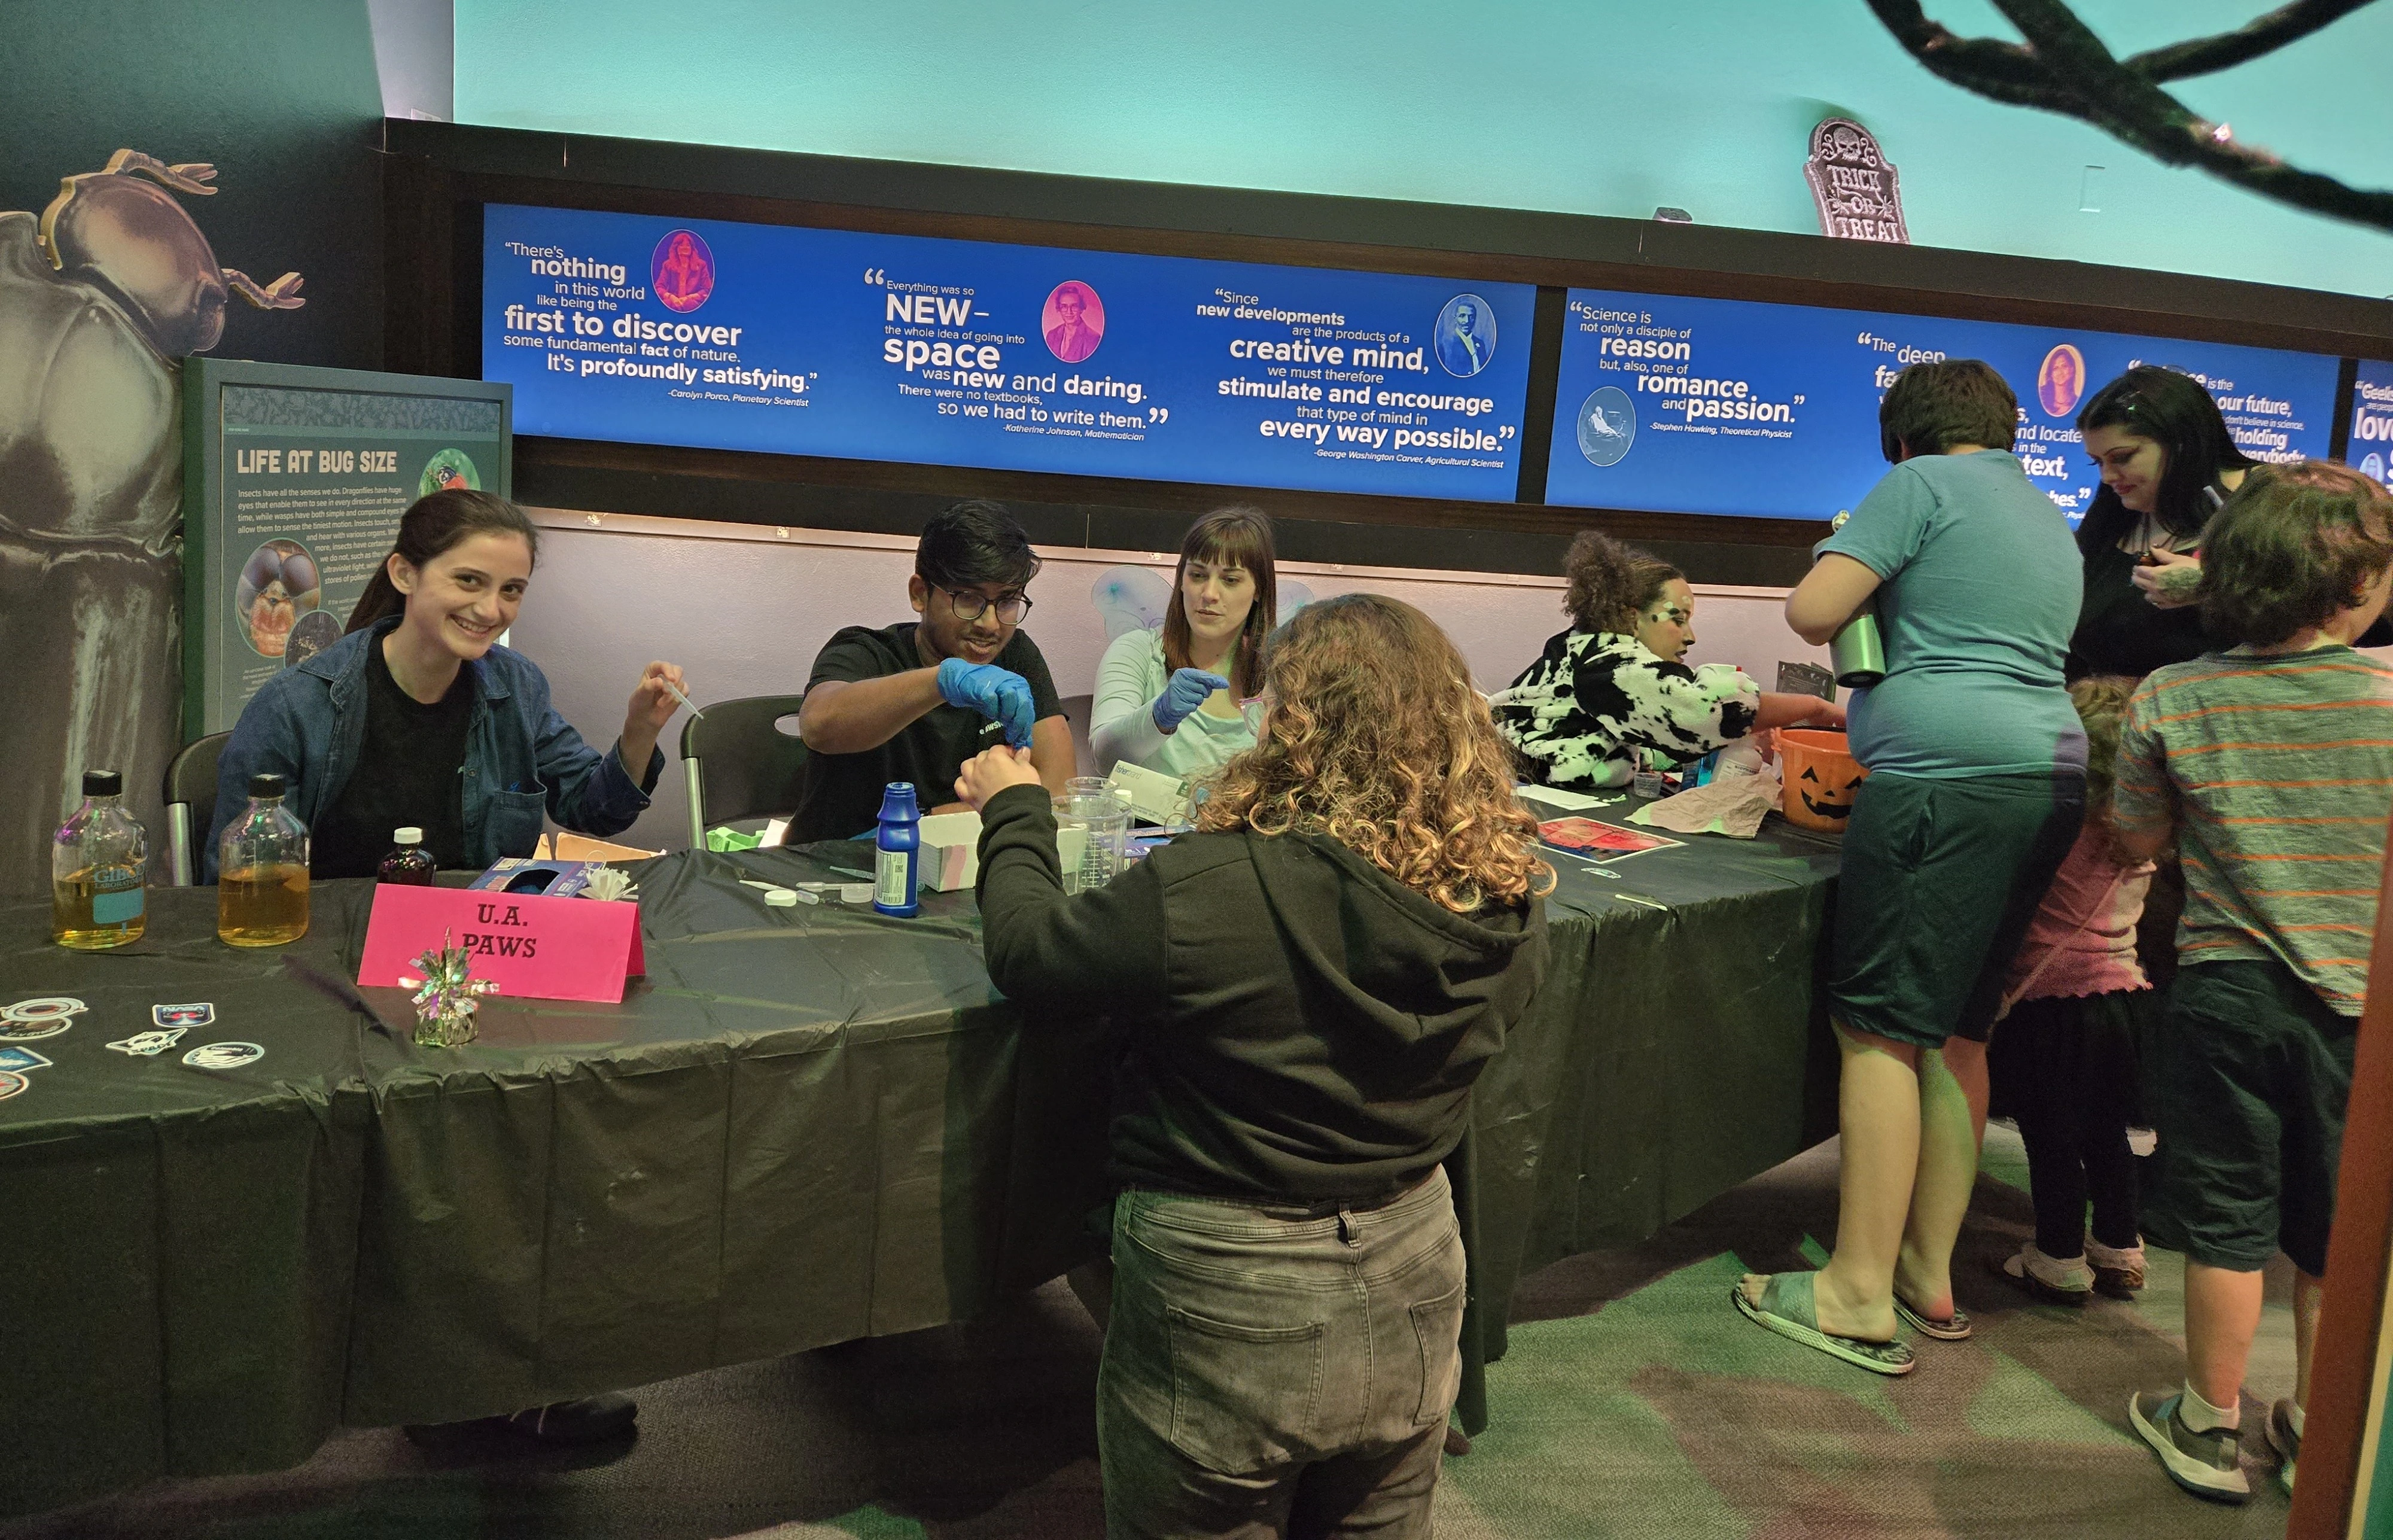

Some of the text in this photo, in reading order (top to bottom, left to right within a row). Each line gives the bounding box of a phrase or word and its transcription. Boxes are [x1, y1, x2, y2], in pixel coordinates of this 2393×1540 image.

[1835, 217, 1899, 241] TREAT
[531, 257, 625, 286] nothing
[555, 282, 645, 300] in this world
[940, 286, 960, 295] was
[537, 294, 617, 312] like being the
[504, 304, 742, 346] first to discover
[1196, 305, 1345, 326] new developments
[1640, 311, 1652, 324] is
[884, 325, 1025, 345] the whole idea of going into
[1292, 327, 1410, 343] are the products of a
[1579, 322, 1599, 332] not
[1600, 323, 1624, 336] only
[1636, 325, 1677, 339] disciple
[1679, 328, 1692, 339] of
[504, 335, 741, 363] some fundamental fact of nature.
[884, 338, 1000, 372] space
[1229, 337, 1429, 375] creative mind,
[1600, 337, 1691, 360] reason
[547, 353, 575, 372] It's
[581, 358, 698, 385] profoundly
[1267, 367, 1384, 384] we must therefore
[1599, 358, 1689, 375] but, also, one of
[897, 384, 1043, 406] There were no textbooks,
[922, 369, 1147, 404] was new and daring.
[1637, 375, 1749, 398] romance
[2208, 378, 2234, 391] is the
[704, 391, 730, 402] Porco,
[732, 394, 773, 406] Planetary
[773, 396, 809, 407] Scientist
[1218, 376, 1494, 416] stimulate and encourage
[1661, 398, 1687, 410] and
[2218, 395, 2292, 418] our future,
[937, 402, 958, 415] so
[963, 404, 988, 418] we
[994, 403, 1025, 421] had
[1030, 407, 1048, 422] to
[1052, 409, 1094, 425] write
[1296, 405, 1428, 426] that type of mind in
[2243, 417, 2268, 427] believe
[2270, 419, 2276, 427] in
[2354, 407, 2393, 441] lov
[1046, 427, 1082, 437] Johnson,
[1084, 429, 1144, 441] Mathematician
[1260, 420, 1331, 445] every
[1336, 425, 1389, 449] way
[1721, 426, 1761, 436] Theoretical
[1760, 428, 1792, 439] Physicist
[2014, 425, 2082, 443] nd locate
[2235, 427, 2288, 451] holding
[2018, 443, 2047, 454] in the
[238, 449, 397, 473] LIFE AT BUG SIZE
[1348, 451, 1395, 462] Washington
[1396, 454, 1423, 464] Carver,
[1424, 456, 1470, 466] Agricultural
[1470, 458, 1504, 468] Scientist
[477, 903, 528, 926] U.A.
[462, 933, 537, 958] PAWS
